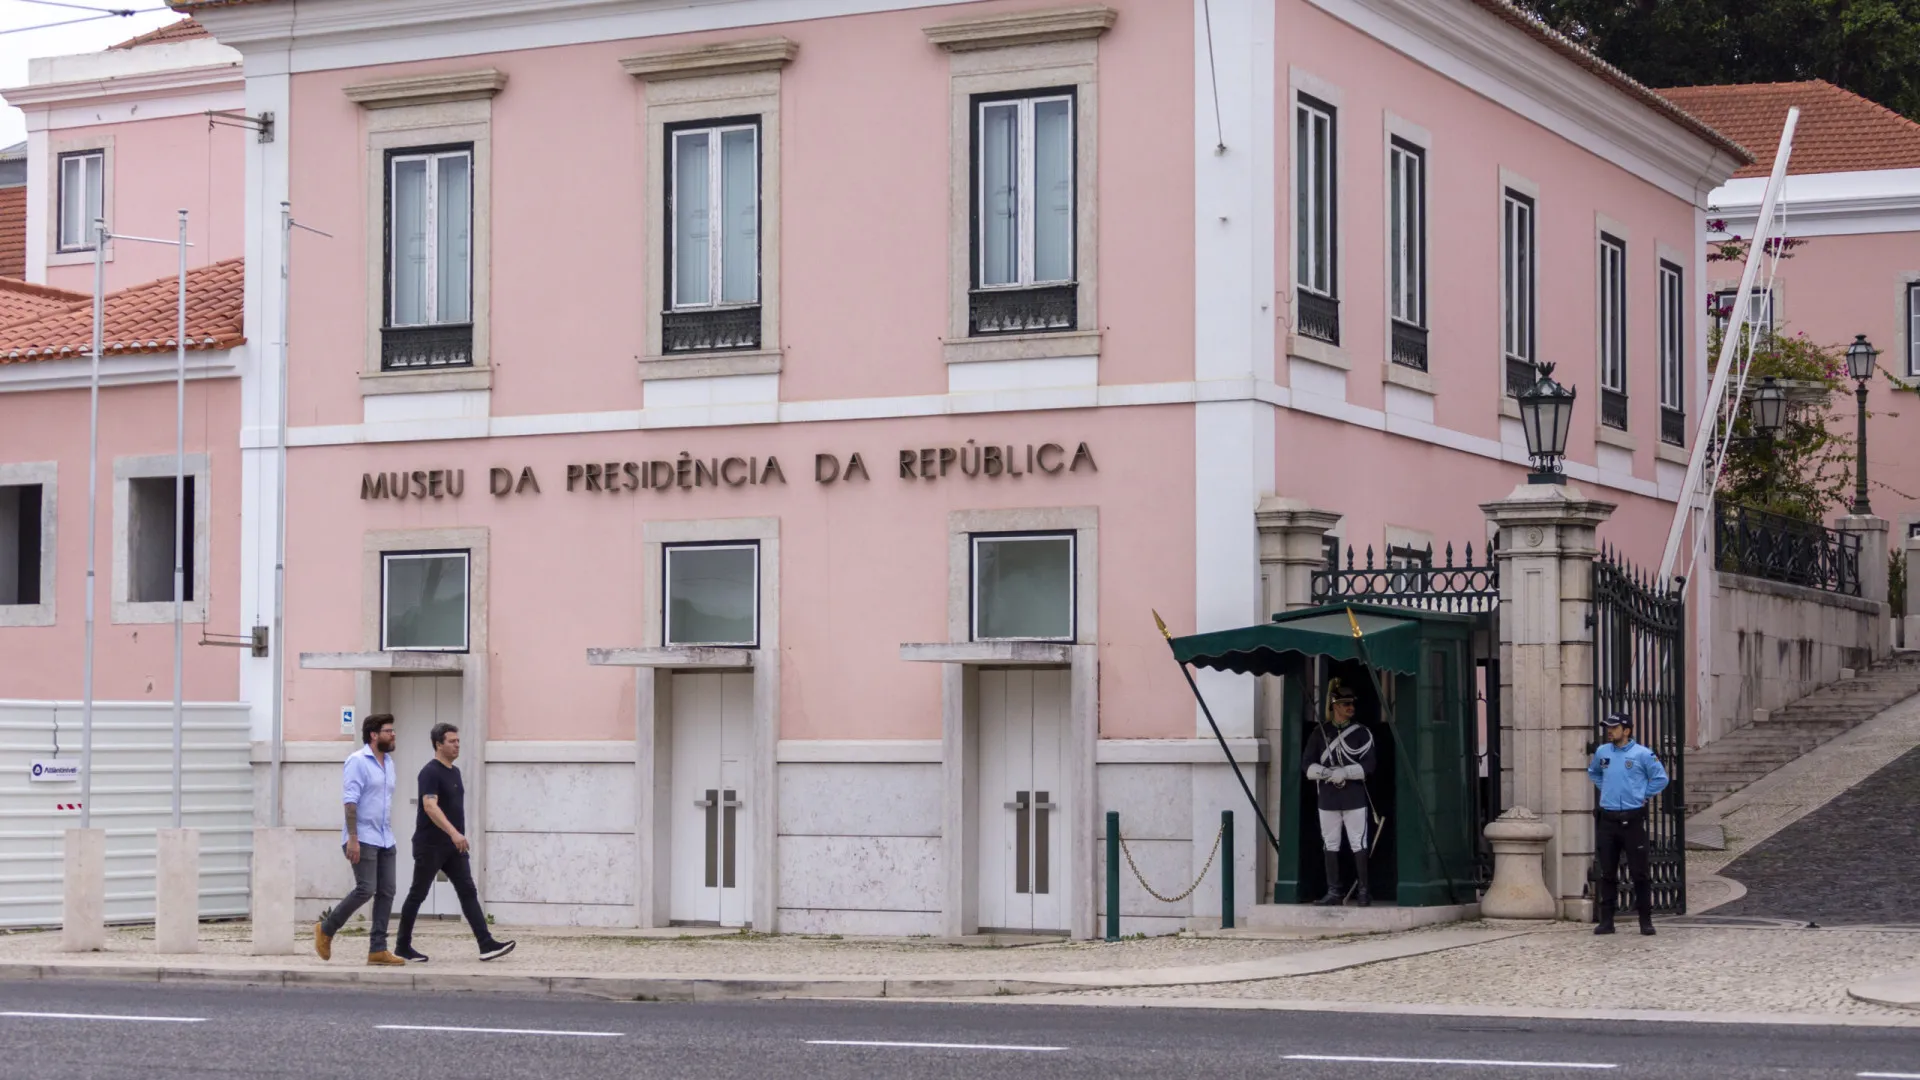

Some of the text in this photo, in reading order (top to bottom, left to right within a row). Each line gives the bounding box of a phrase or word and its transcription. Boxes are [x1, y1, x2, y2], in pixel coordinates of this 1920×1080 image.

[360, 438, 1098, 499] MUSEU DA PRESIDÊNCIA DA REPÚBLICA
